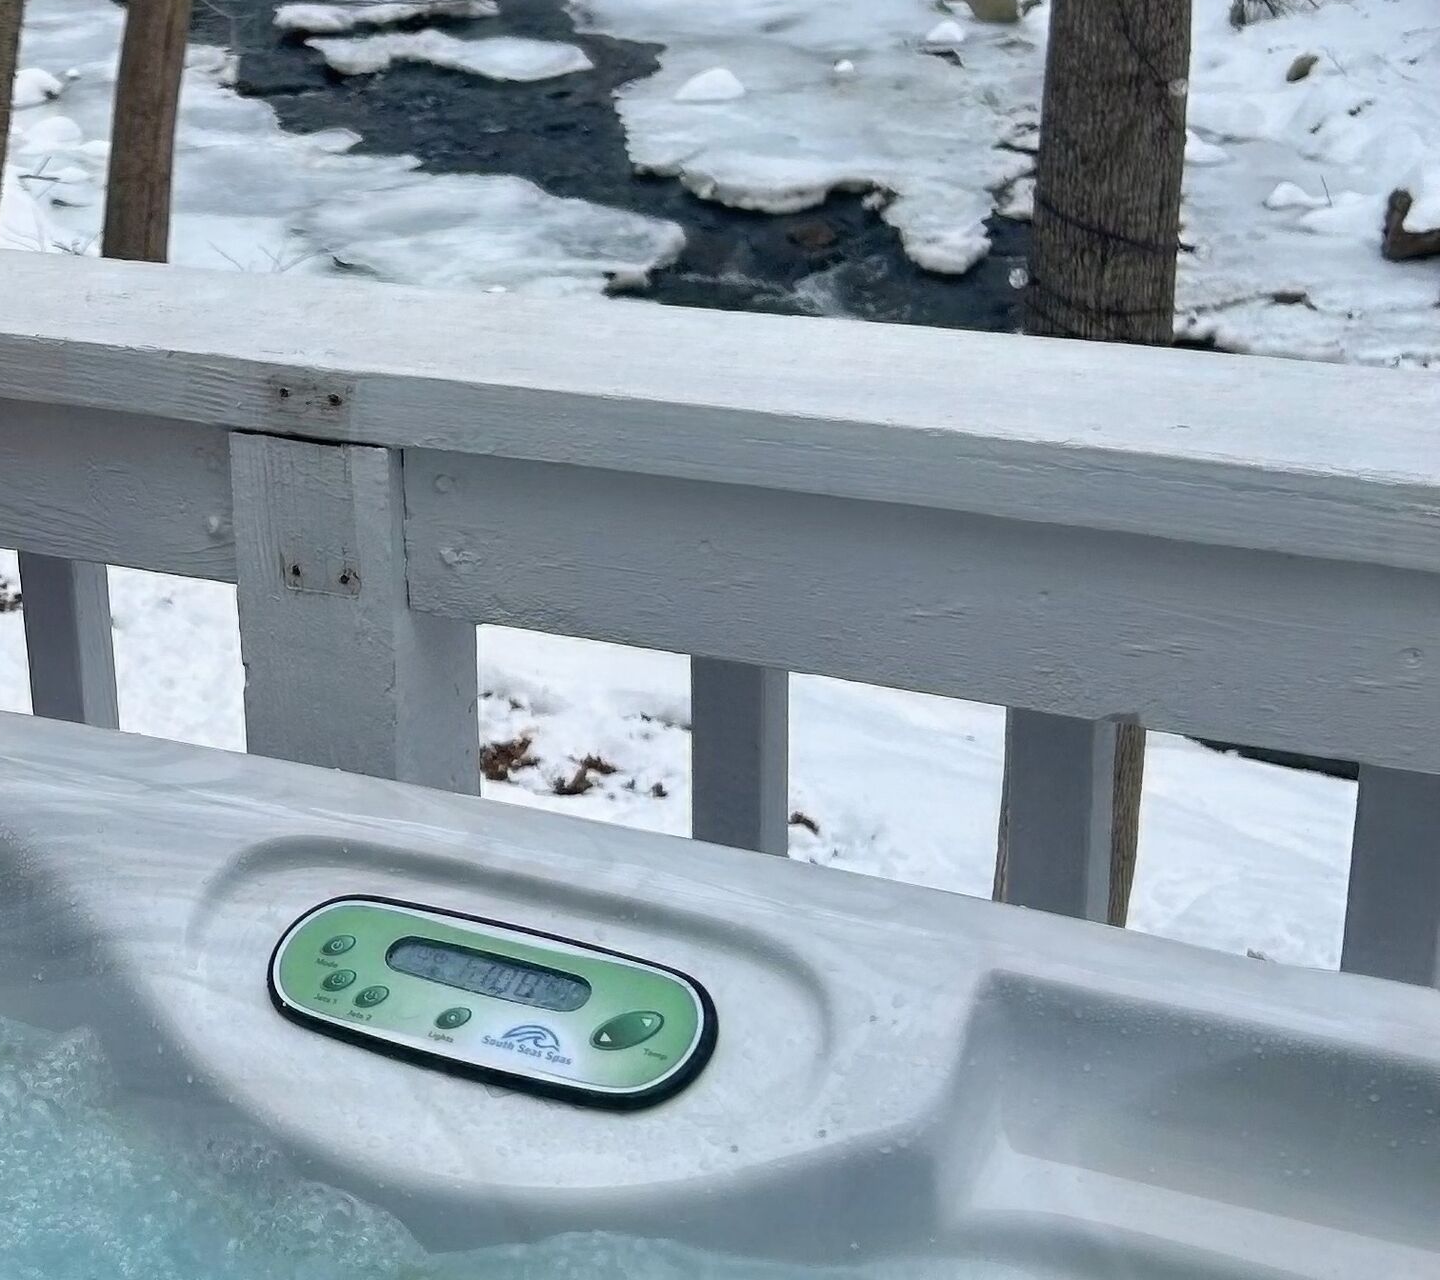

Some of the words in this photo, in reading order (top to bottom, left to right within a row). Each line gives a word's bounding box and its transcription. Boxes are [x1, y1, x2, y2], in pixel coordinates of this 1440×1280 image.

[316, 958, 338, 968] Mode
[347, 1010, 363, 1019] Jets
[428, 1030, 454, 1044] Lights
[481, 1034, 514, 1051] South
[517, 1044, 542, 1058] Seas
[545, 1051, 573, 1066] Spas
